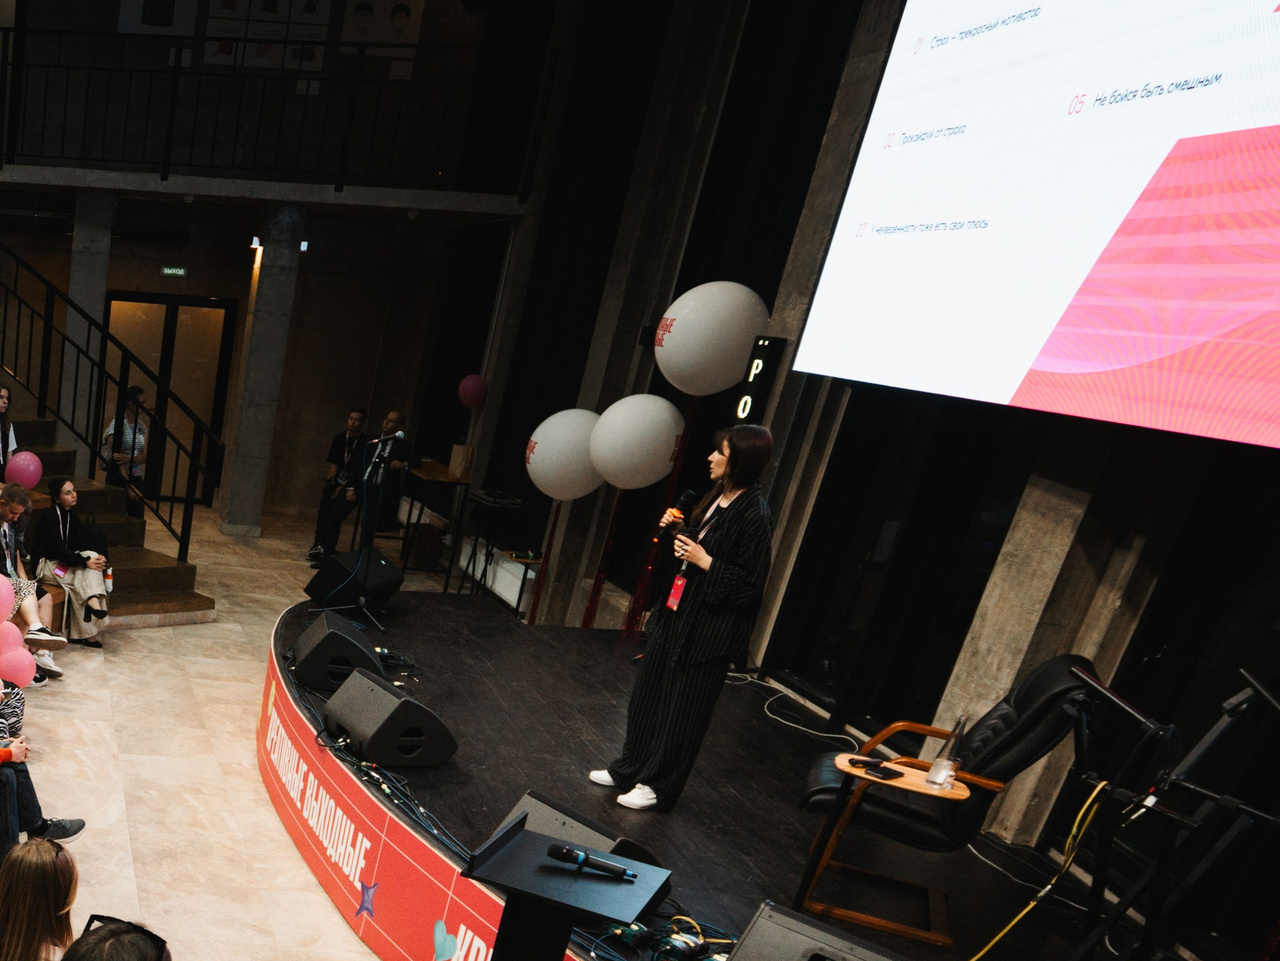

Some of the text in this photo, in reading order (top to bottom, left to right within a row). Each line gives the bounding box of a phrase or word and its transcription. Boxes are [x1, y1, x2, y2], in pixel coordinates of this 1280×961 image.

[1068, 73, 1223, 115] 05 Не бойся быть смешным
[302, 771, 372, 891] ВЫХОДНЫЕ
